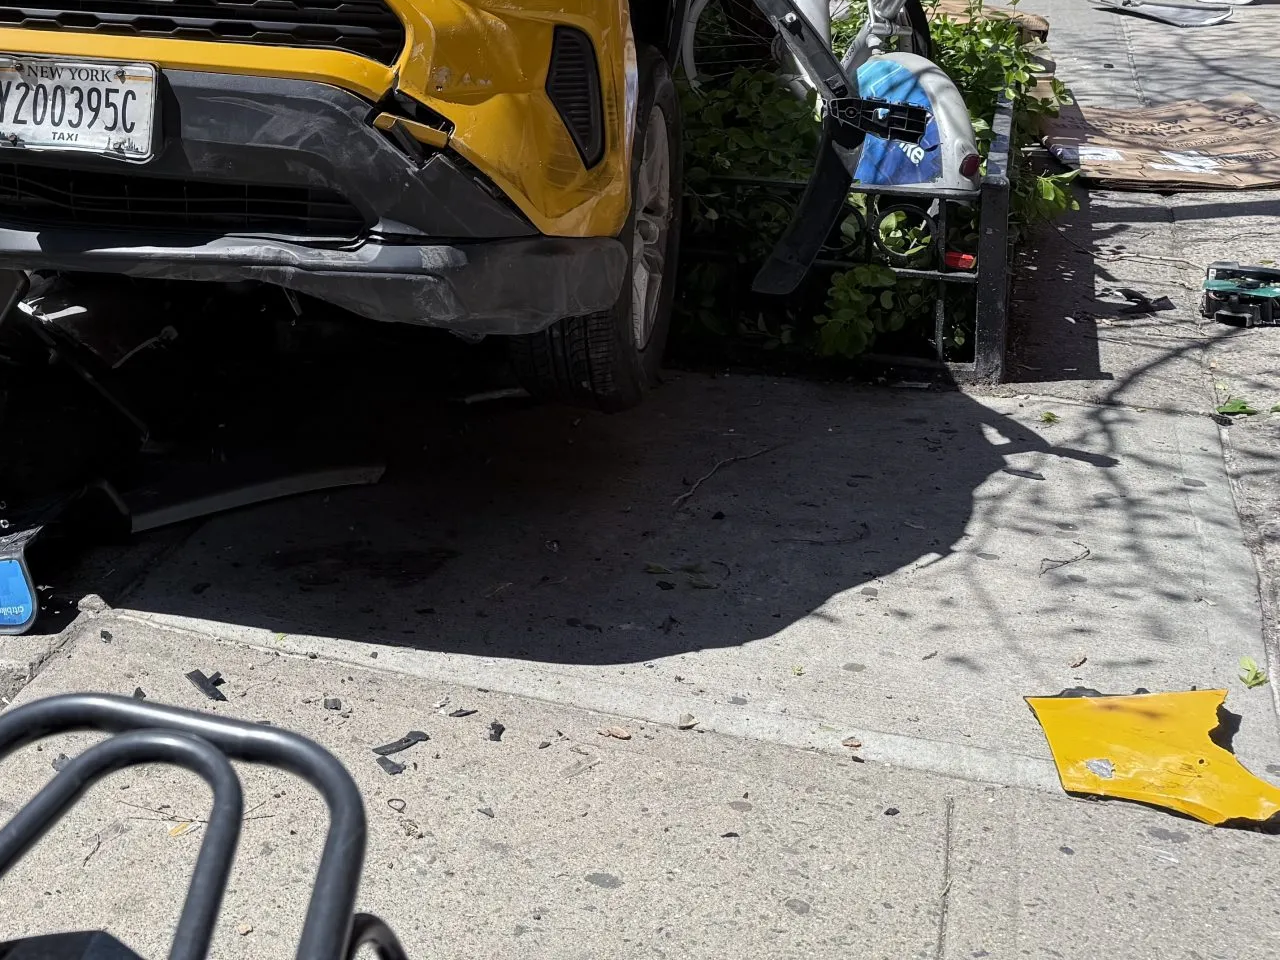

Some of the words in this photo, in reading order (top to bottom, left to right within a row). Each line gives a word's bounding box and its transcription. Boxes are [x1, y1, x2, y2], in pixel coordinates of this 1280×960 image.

[26, 66, 66, 81] NEW
[69, 67, 113, 83] YORK
[51, 131, 79, 142] TAXI
